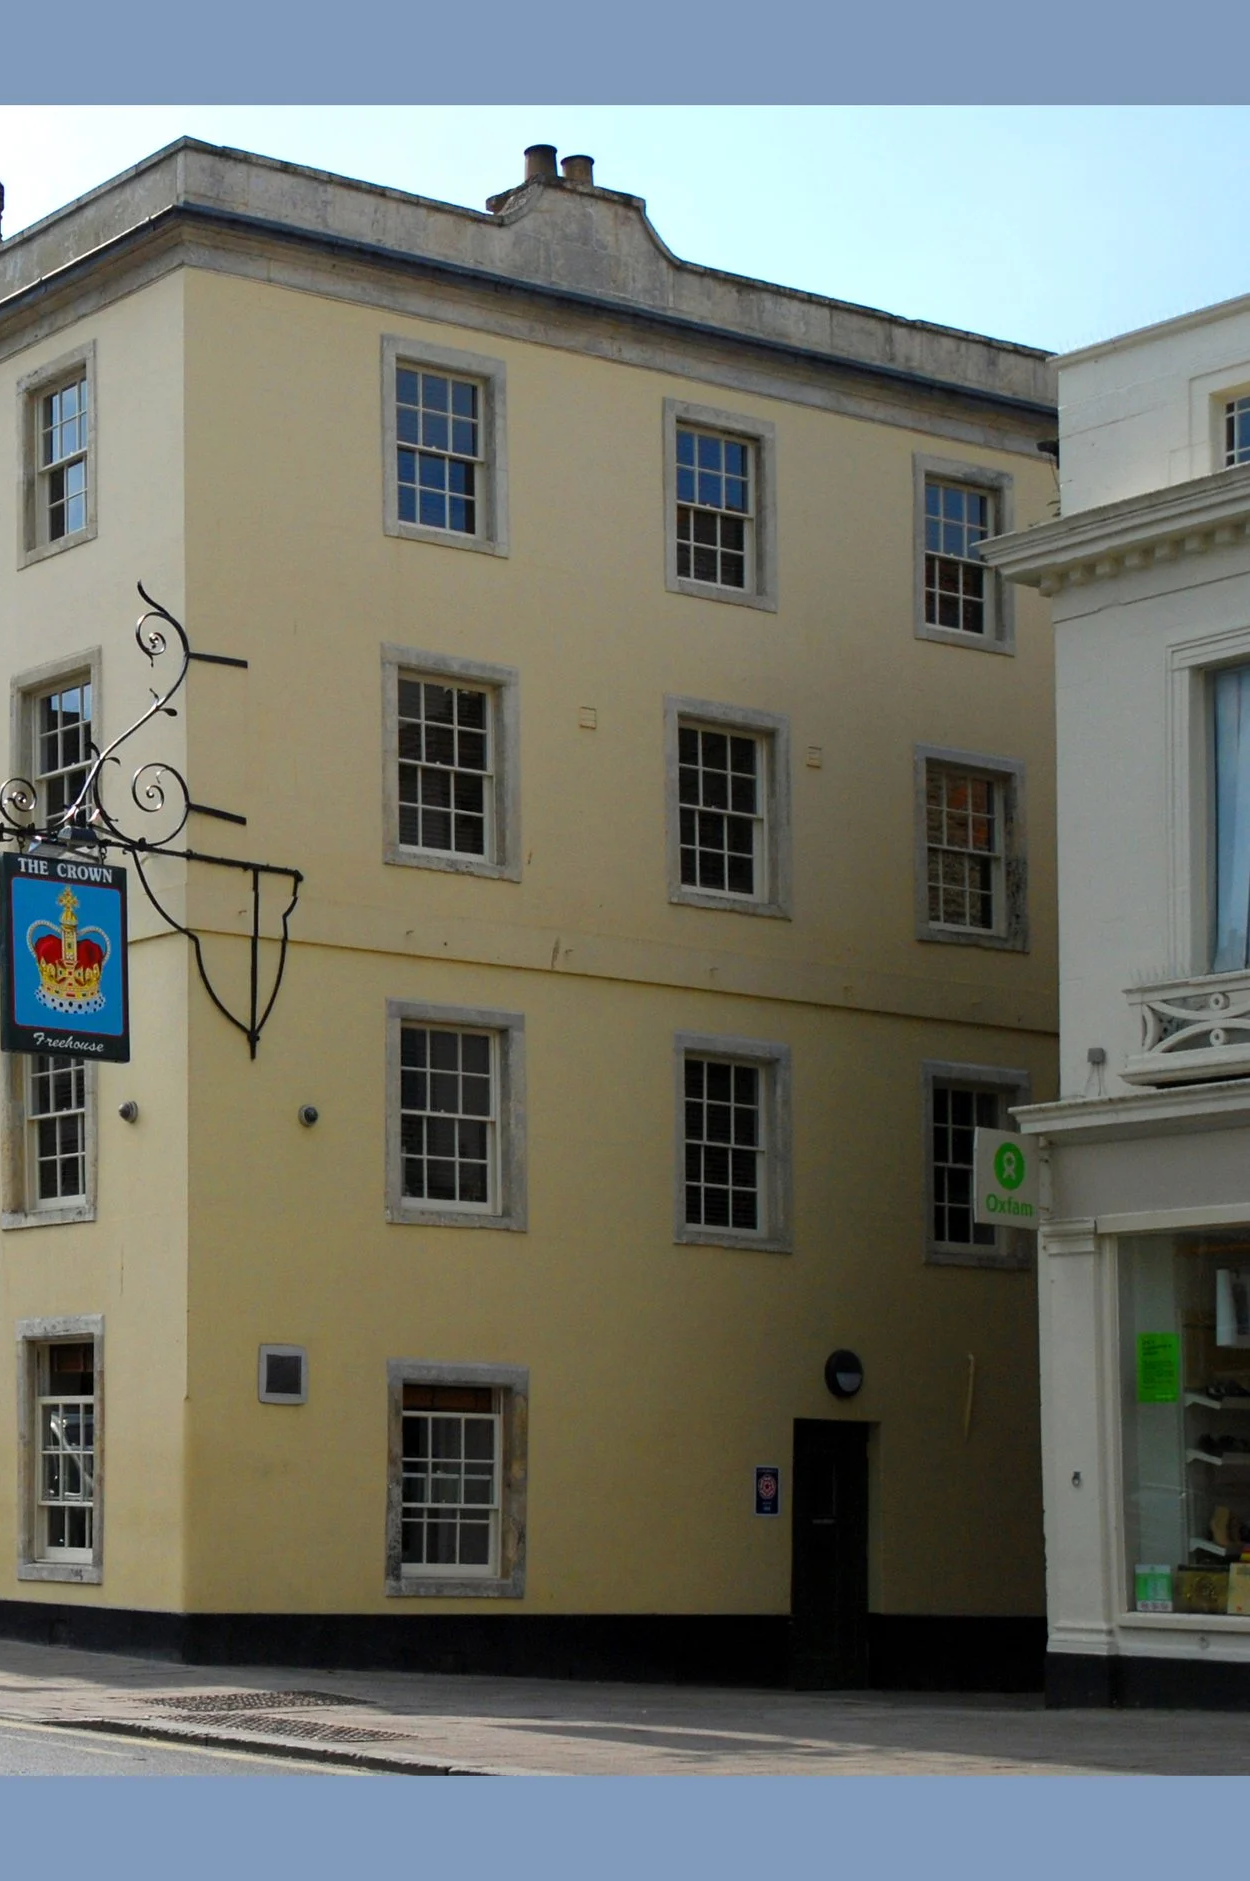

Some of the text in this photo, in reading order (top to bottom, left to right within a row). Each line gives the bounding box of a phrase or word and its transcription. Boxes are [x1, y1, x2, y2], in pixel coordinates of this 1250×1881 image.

[17, 857, 113, 883] THE CROWN
[33, 1032, 104, 1053] Freehouse
[985, 1193, 1034, 1217] Oxfam
